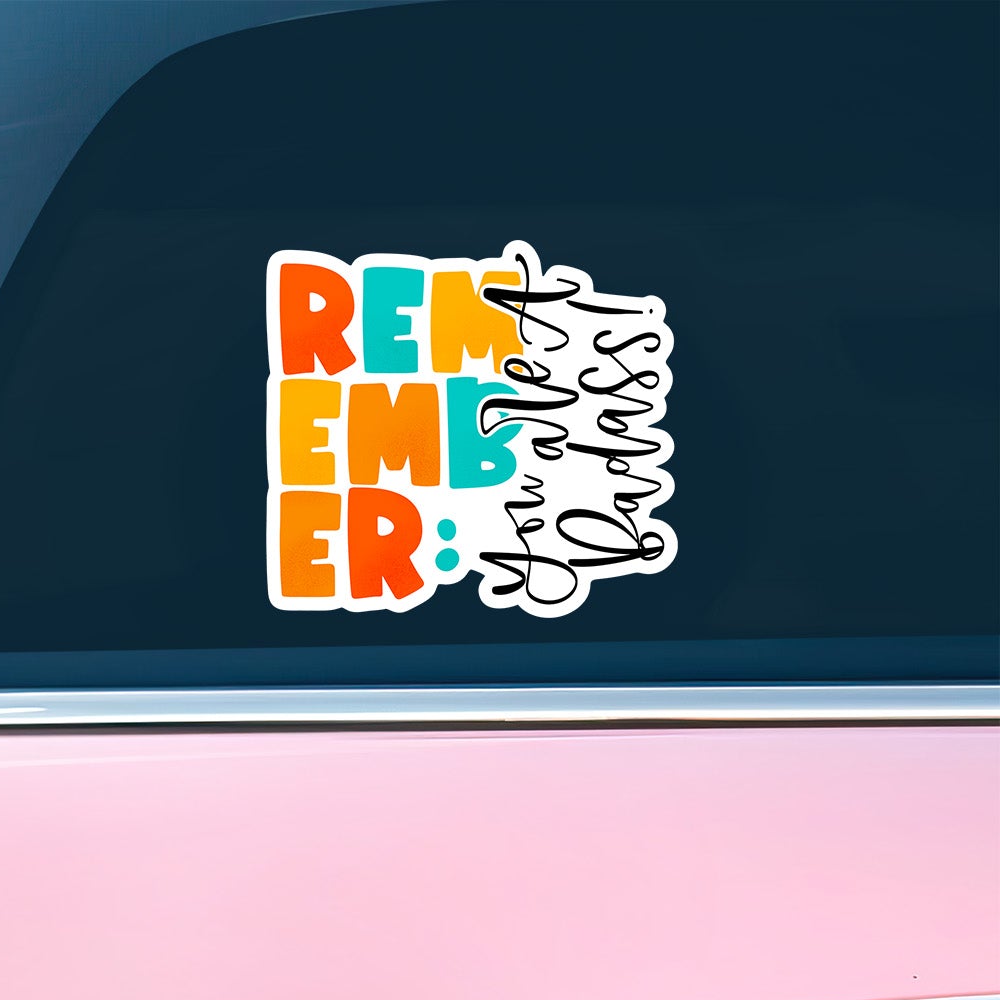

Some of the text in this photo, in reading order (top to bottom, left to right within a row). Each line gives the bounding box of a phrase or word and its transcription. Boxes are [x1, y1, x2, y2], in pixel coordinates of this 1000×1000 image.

[279, 263, 524, 375] REM
[483, 253, 581, 352] A
[279, 377, 524, 489] EMB
[555, 300, 665, 567] Badass!
[279, 487, 460, 599] ER:
